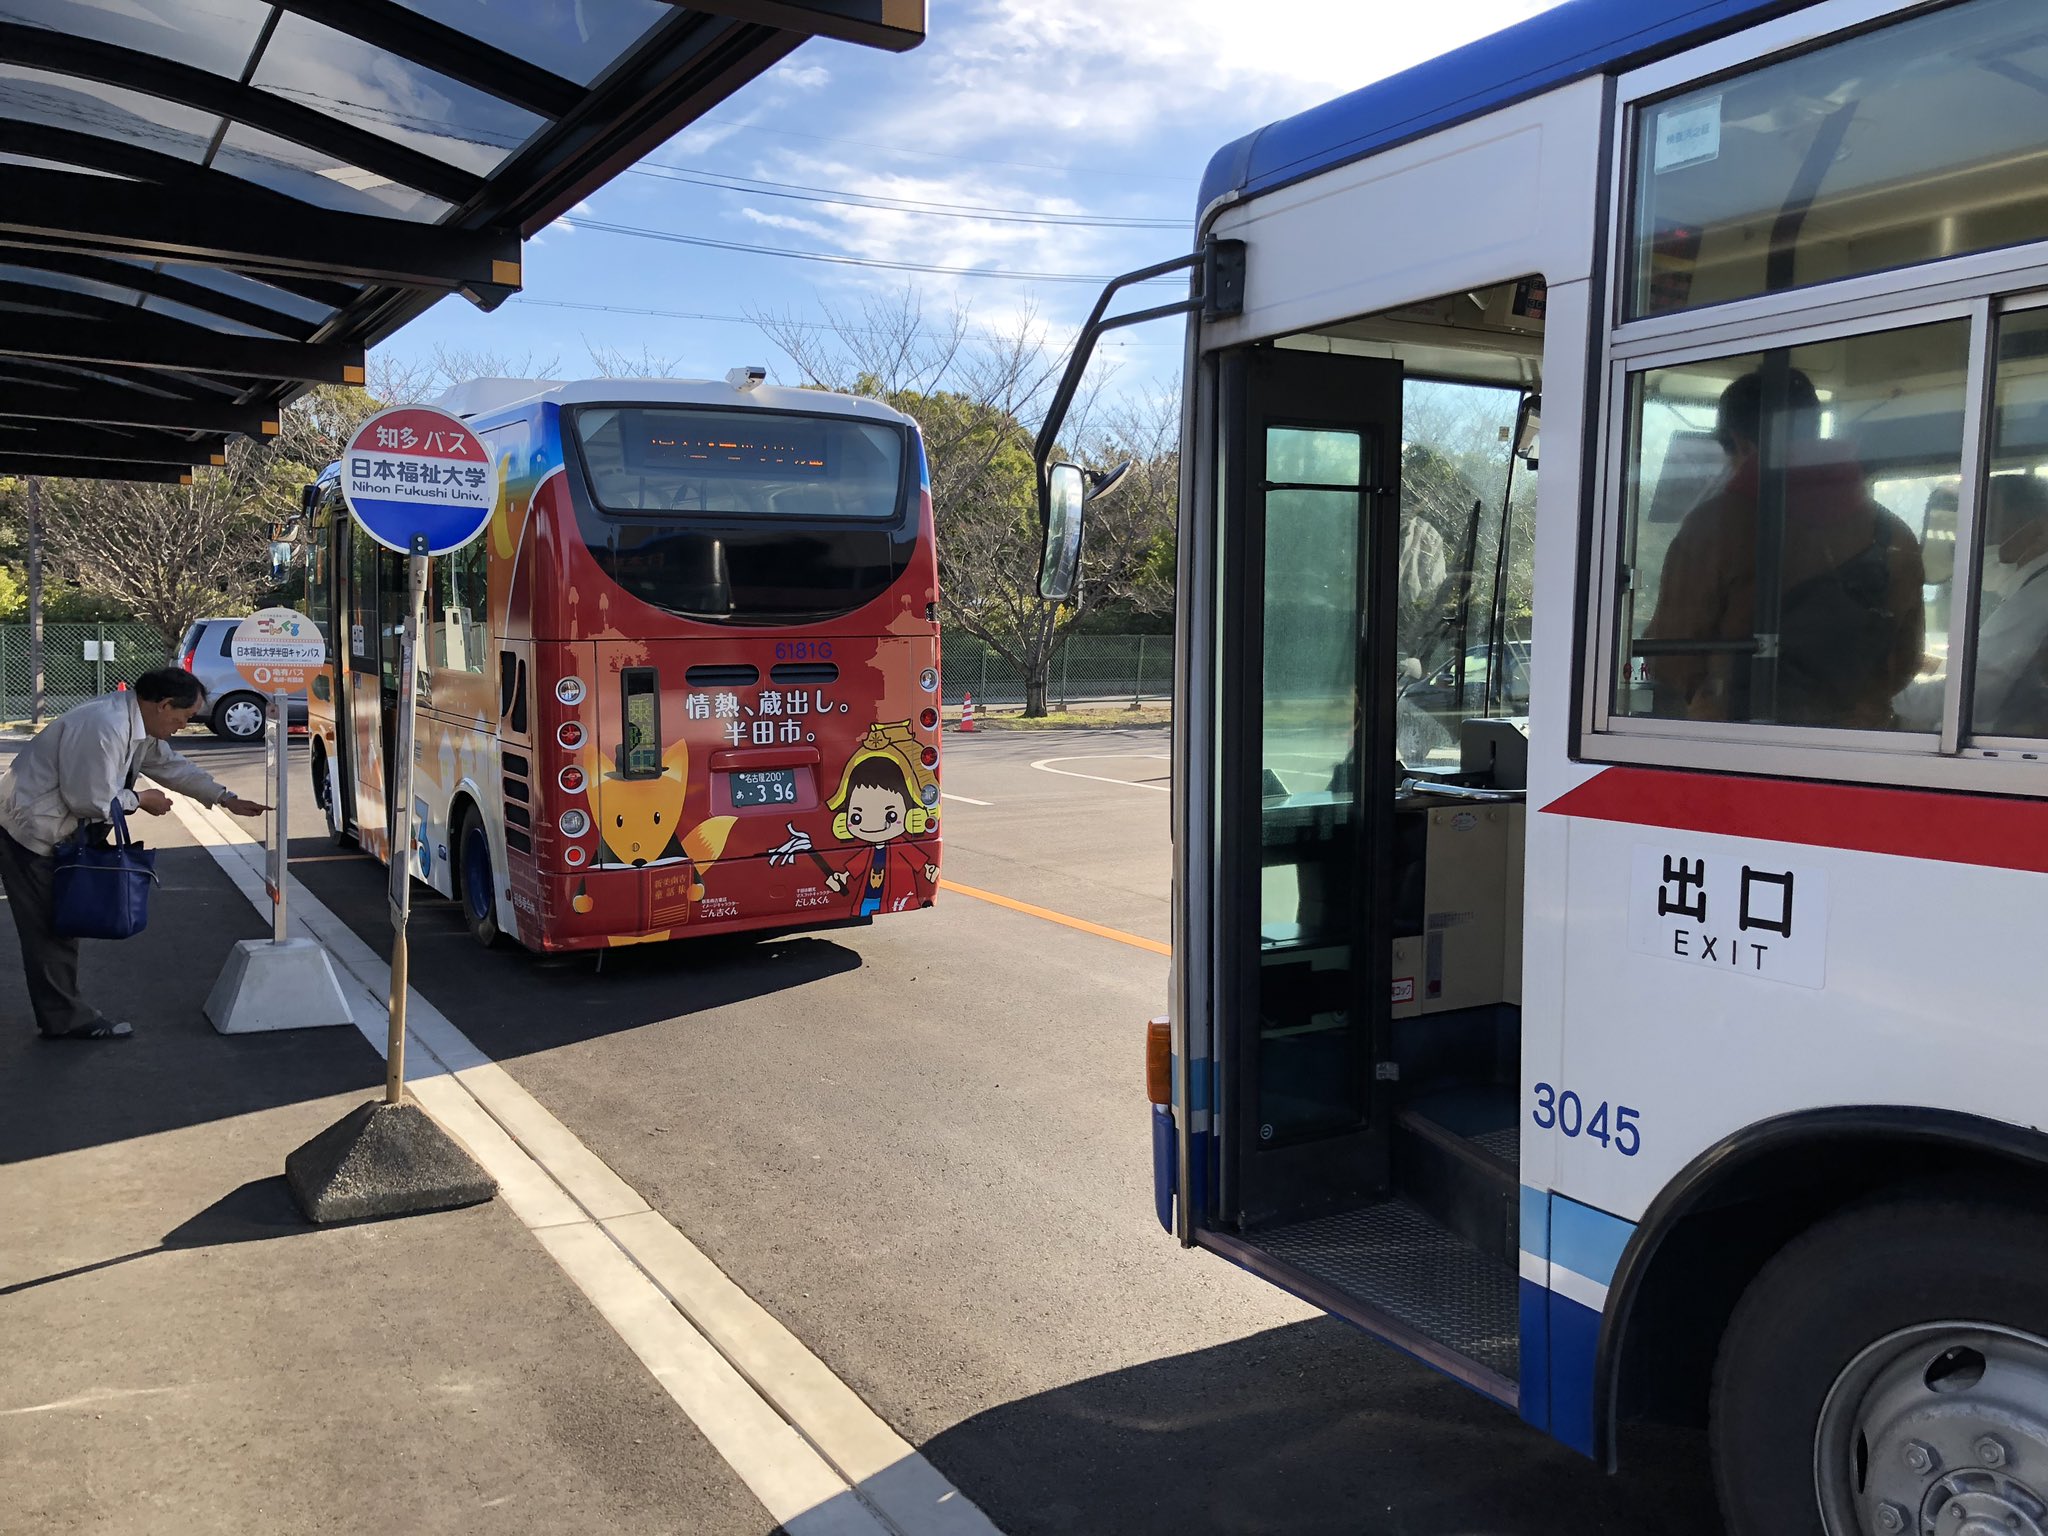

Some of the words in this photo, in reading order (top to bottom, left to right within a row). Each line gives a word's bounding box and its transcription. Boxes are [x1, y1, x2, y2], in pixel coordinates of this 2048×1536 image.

[375, 424, 468, 455] 知多バス
[351, 458, 486, 489] 日本福祉大学
[352, 480, 391, 494] Nihon
[394, 484, 447, 499] Fukushi
[451, 489, 484, 502] Univ.
[257, 617, 300, 637] ごんぐる
[236, 646, 320, 658] 日本福祉大学半田キャンパス
[775, 641, 833, 660] 6181G
[685, 689, 849, 720] 情熱、蔵出し。
[723, 718, 816, 747] 半田市。
[745, 772, 782, 784] 名古屋200
[736, 790, 744, 800] あ
[795, 896, 829, 907] だし丸くん
[1658, 854, 1794, 938] 出口
[700, 907, 738, 918] ごん吉くん
[1674, 929, 1768, 970] EXIT
[1532, 1082, 1641, 1156] 3045
